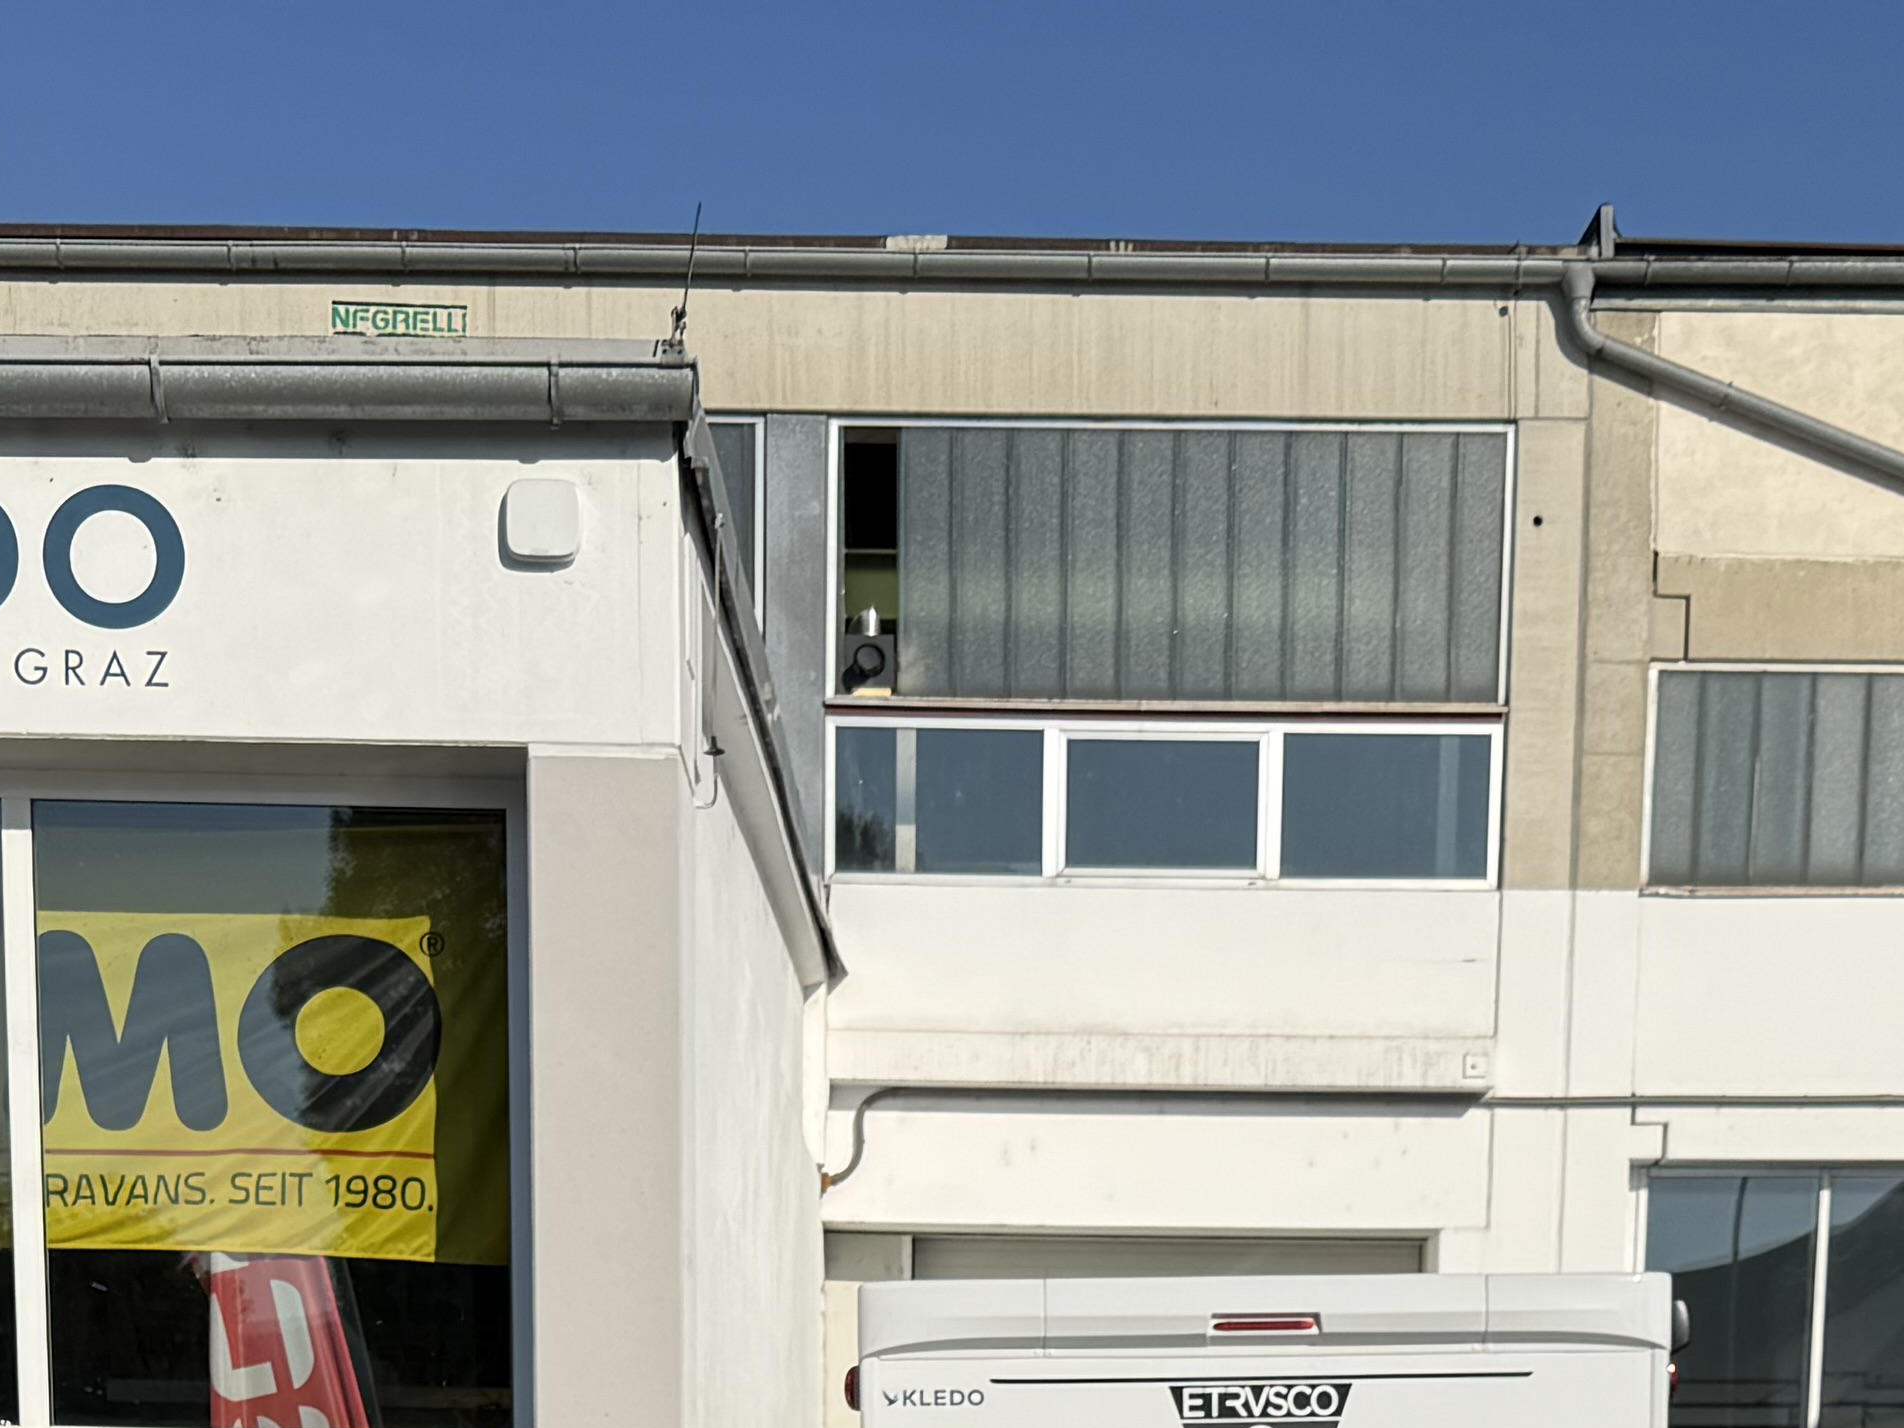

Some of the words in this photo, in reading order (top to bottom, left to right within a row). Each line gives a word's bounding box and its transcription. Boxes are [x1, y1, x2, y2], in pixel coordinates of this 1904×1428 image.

[12, 646, 171, 689] GRAZ
[229, 1171, 315, 1208] SEIT
[324, 1173, 436, 1213] 1980.
[902, 1388, 985, 1407] KLEDO
